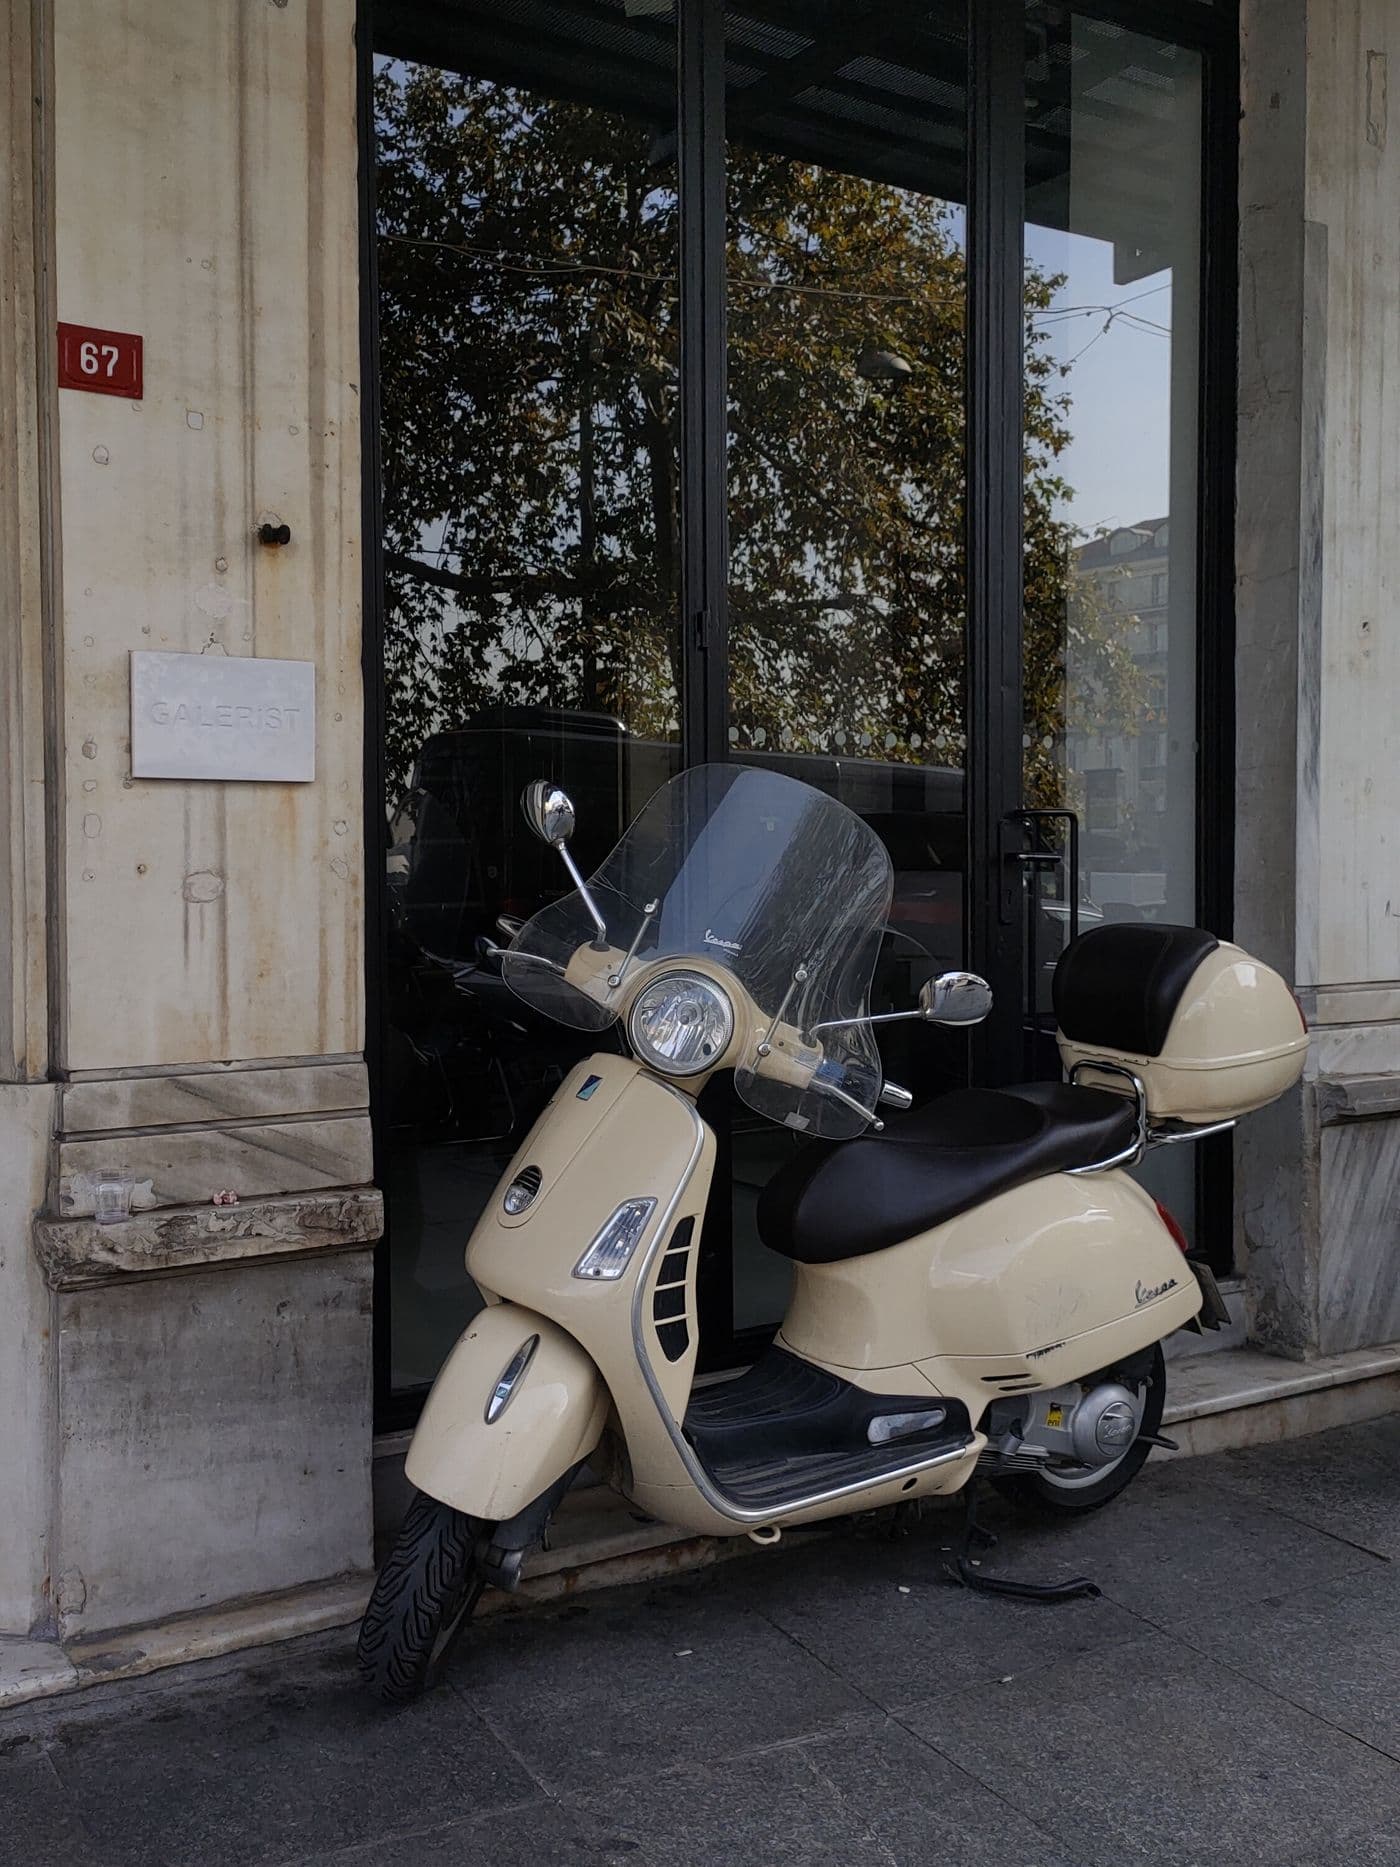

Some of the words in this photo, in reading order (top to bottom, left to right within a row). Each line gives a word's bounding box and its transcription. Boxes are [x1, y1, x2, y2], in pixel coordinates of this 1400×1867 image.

[80, 341, 119, 377] 67
[151, 702, 301, 730] GALERIST
[703, 928, 743, 951] Vespa
[1134, 1279, 1178, 1309] Vespa
